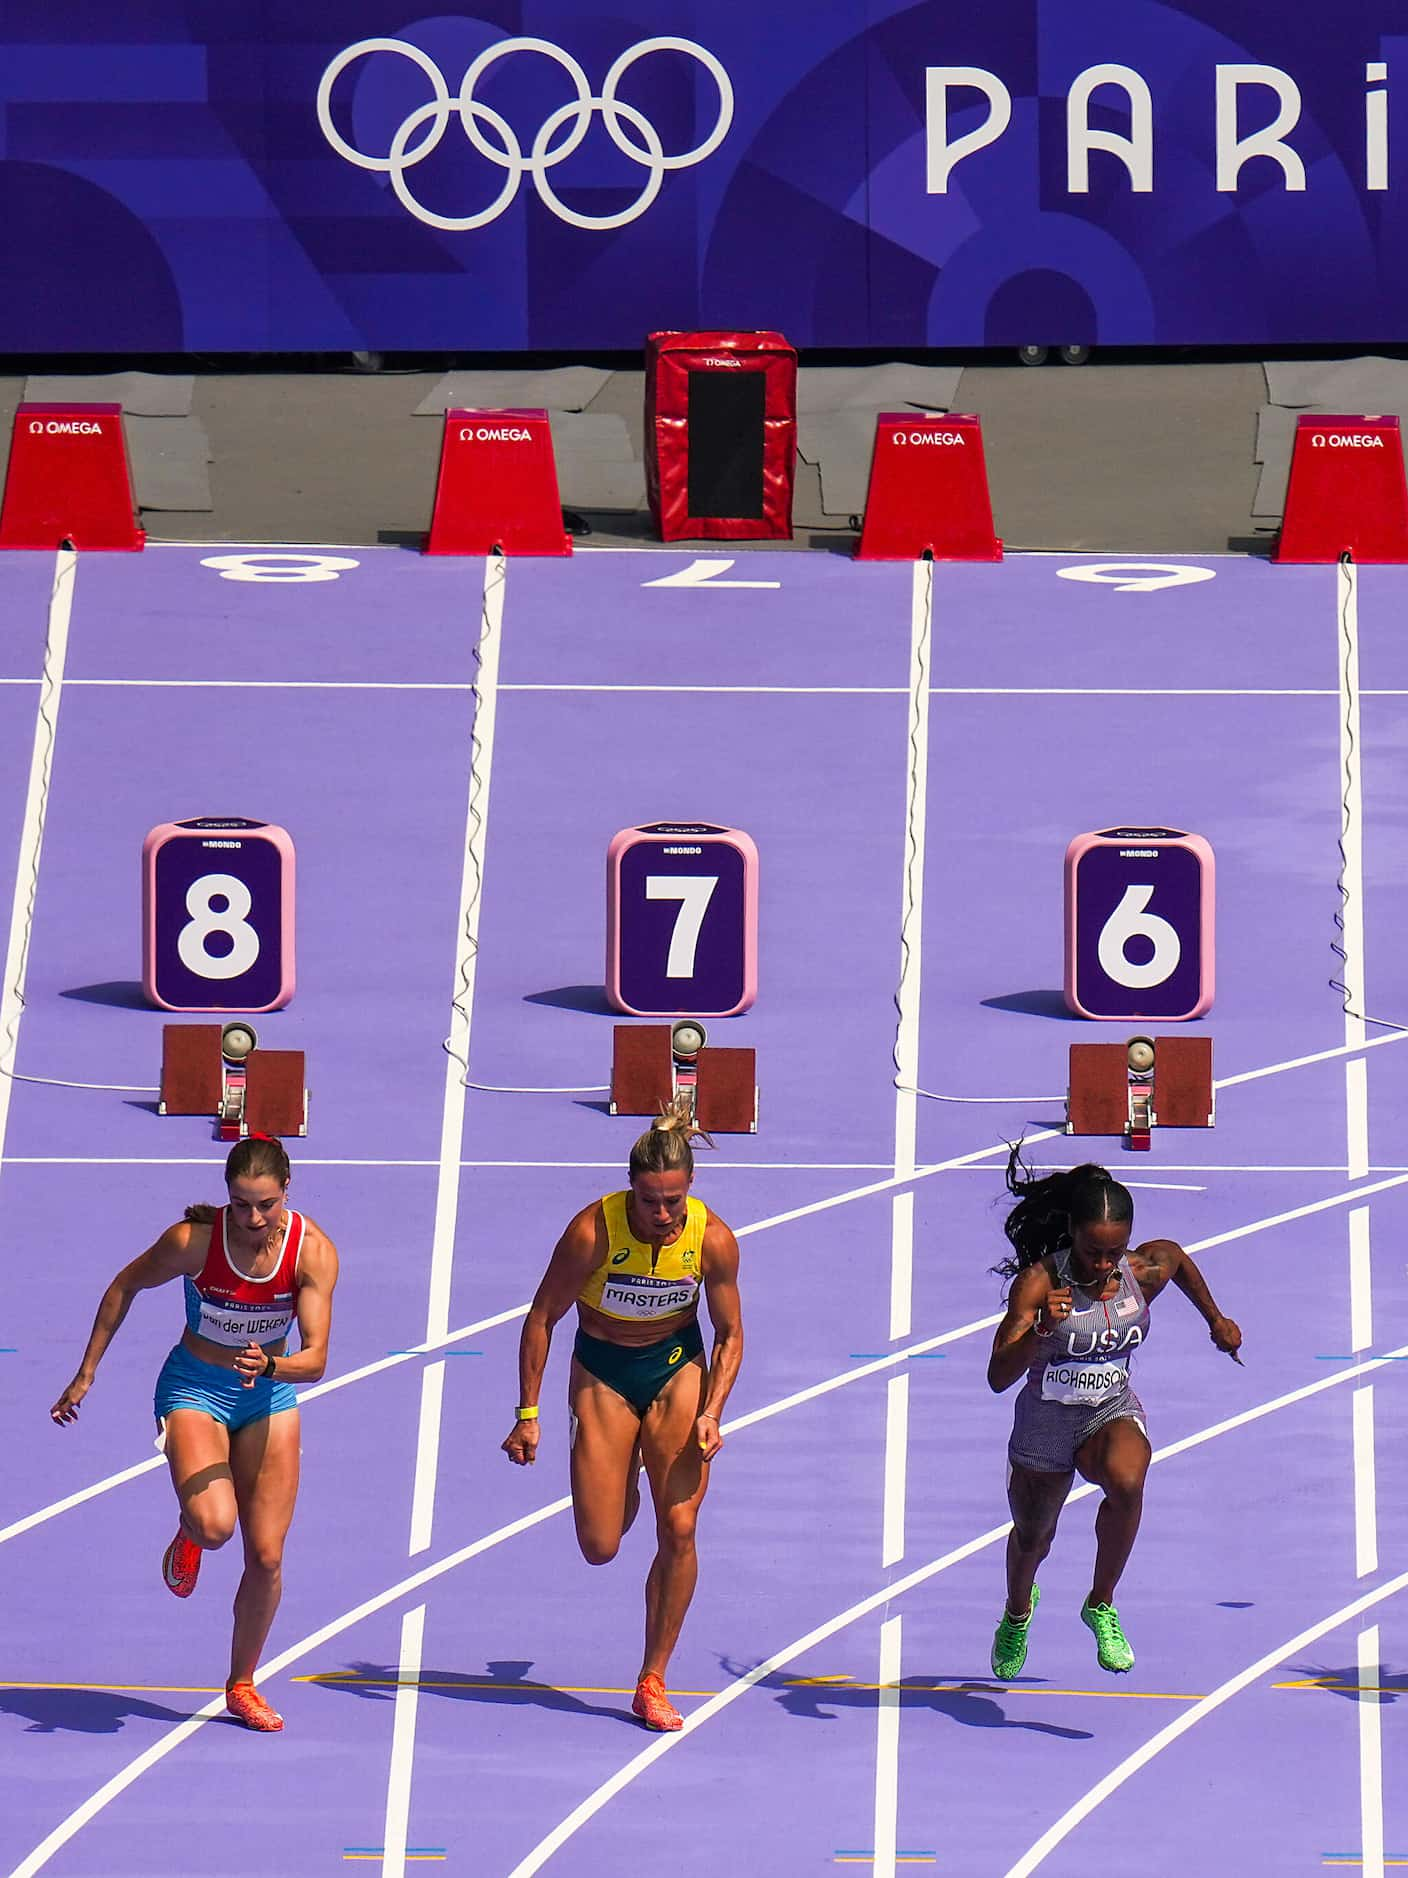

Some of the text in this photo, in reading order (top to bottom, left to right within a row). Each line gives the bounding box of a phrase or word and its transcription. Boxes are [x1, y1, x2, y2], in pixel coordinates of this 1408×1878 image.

[47, 421, 102, 435] OMEGA
[476, 428, 532, 441] OMEGA
[910, 432, 965, 446] OMEGA
[1328, 434, 1384, 448] OMEGA
[200, 554, 360, 582] 8
[642, 559, 781, 588] 7
[209, 840, 242, 849] MONDO
[670, 846, 702, 855] MONDO
[1126, 849, 1159, 858] MONDO
[177, 873, 260, 980] 8
[646, 875, 719, 978] 7
[1097, 884, 1181, 989] 6
[606, 1287, 690, 1308] MASTERS
[223, 1319, 245, 1334] der
[247, 1316, 288, 1334] WEKEN
[1067, 1325, 1143, 1356] USA
